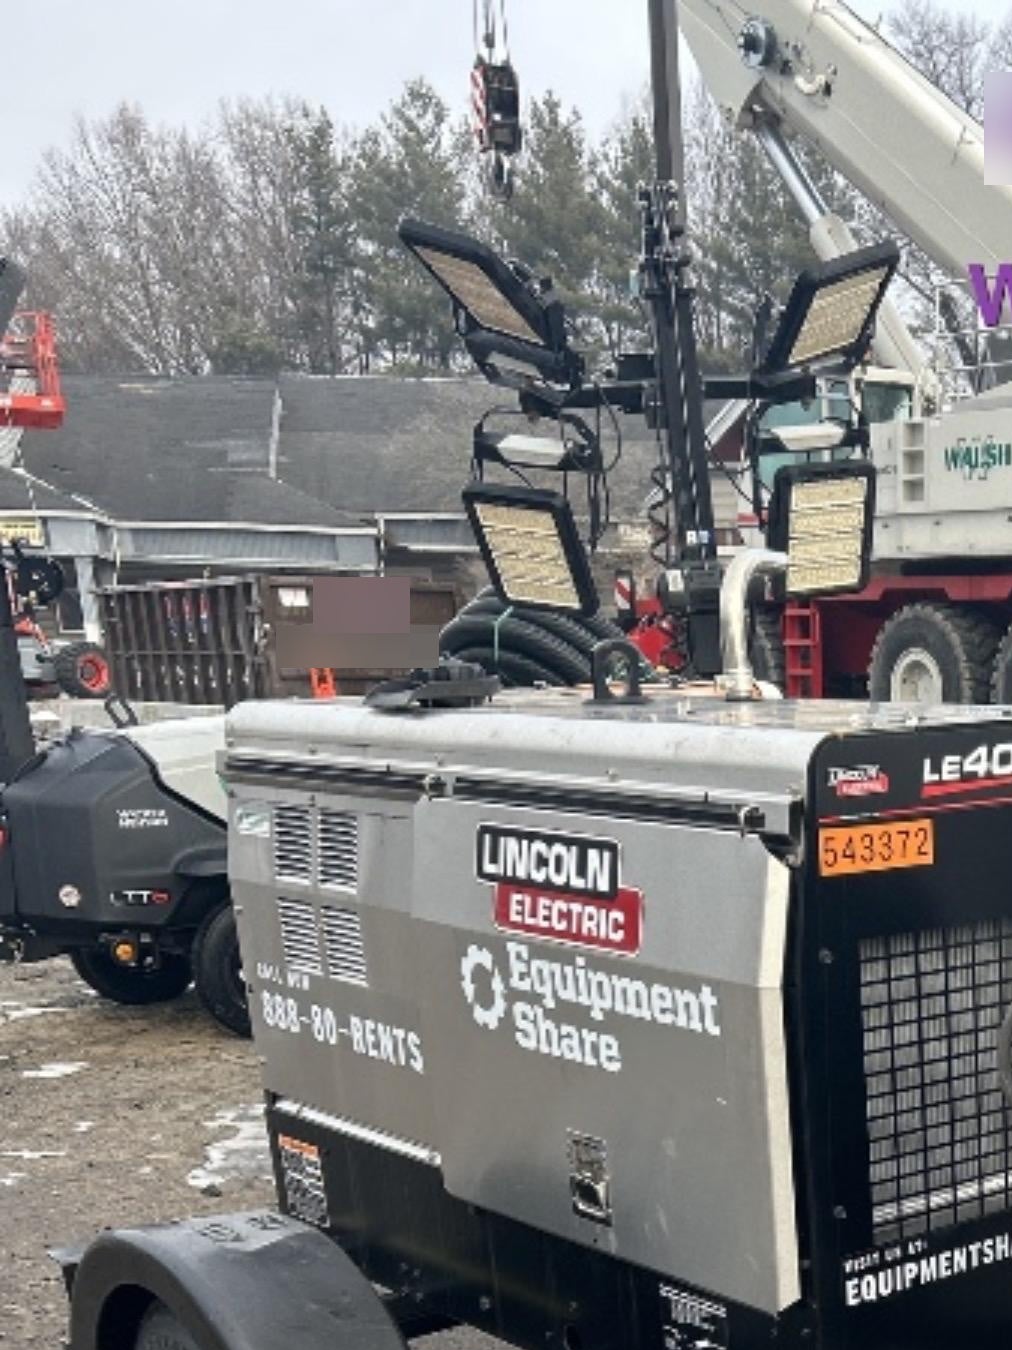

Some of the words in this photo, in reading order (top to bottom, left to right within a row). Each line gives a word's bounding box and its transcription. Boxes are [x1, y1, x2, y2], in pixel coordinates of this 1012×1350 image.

[482, 833, 610, 892] LINCOLN
[823, 828, 929, 868] 543372
[509, 893, 624, 941] ELECTRIC
[506, 942, 720, 1036] Equipment
[262, 990, 424, 1074] 888-80-RENTS
[513, 1001, 621, 1072] Share
